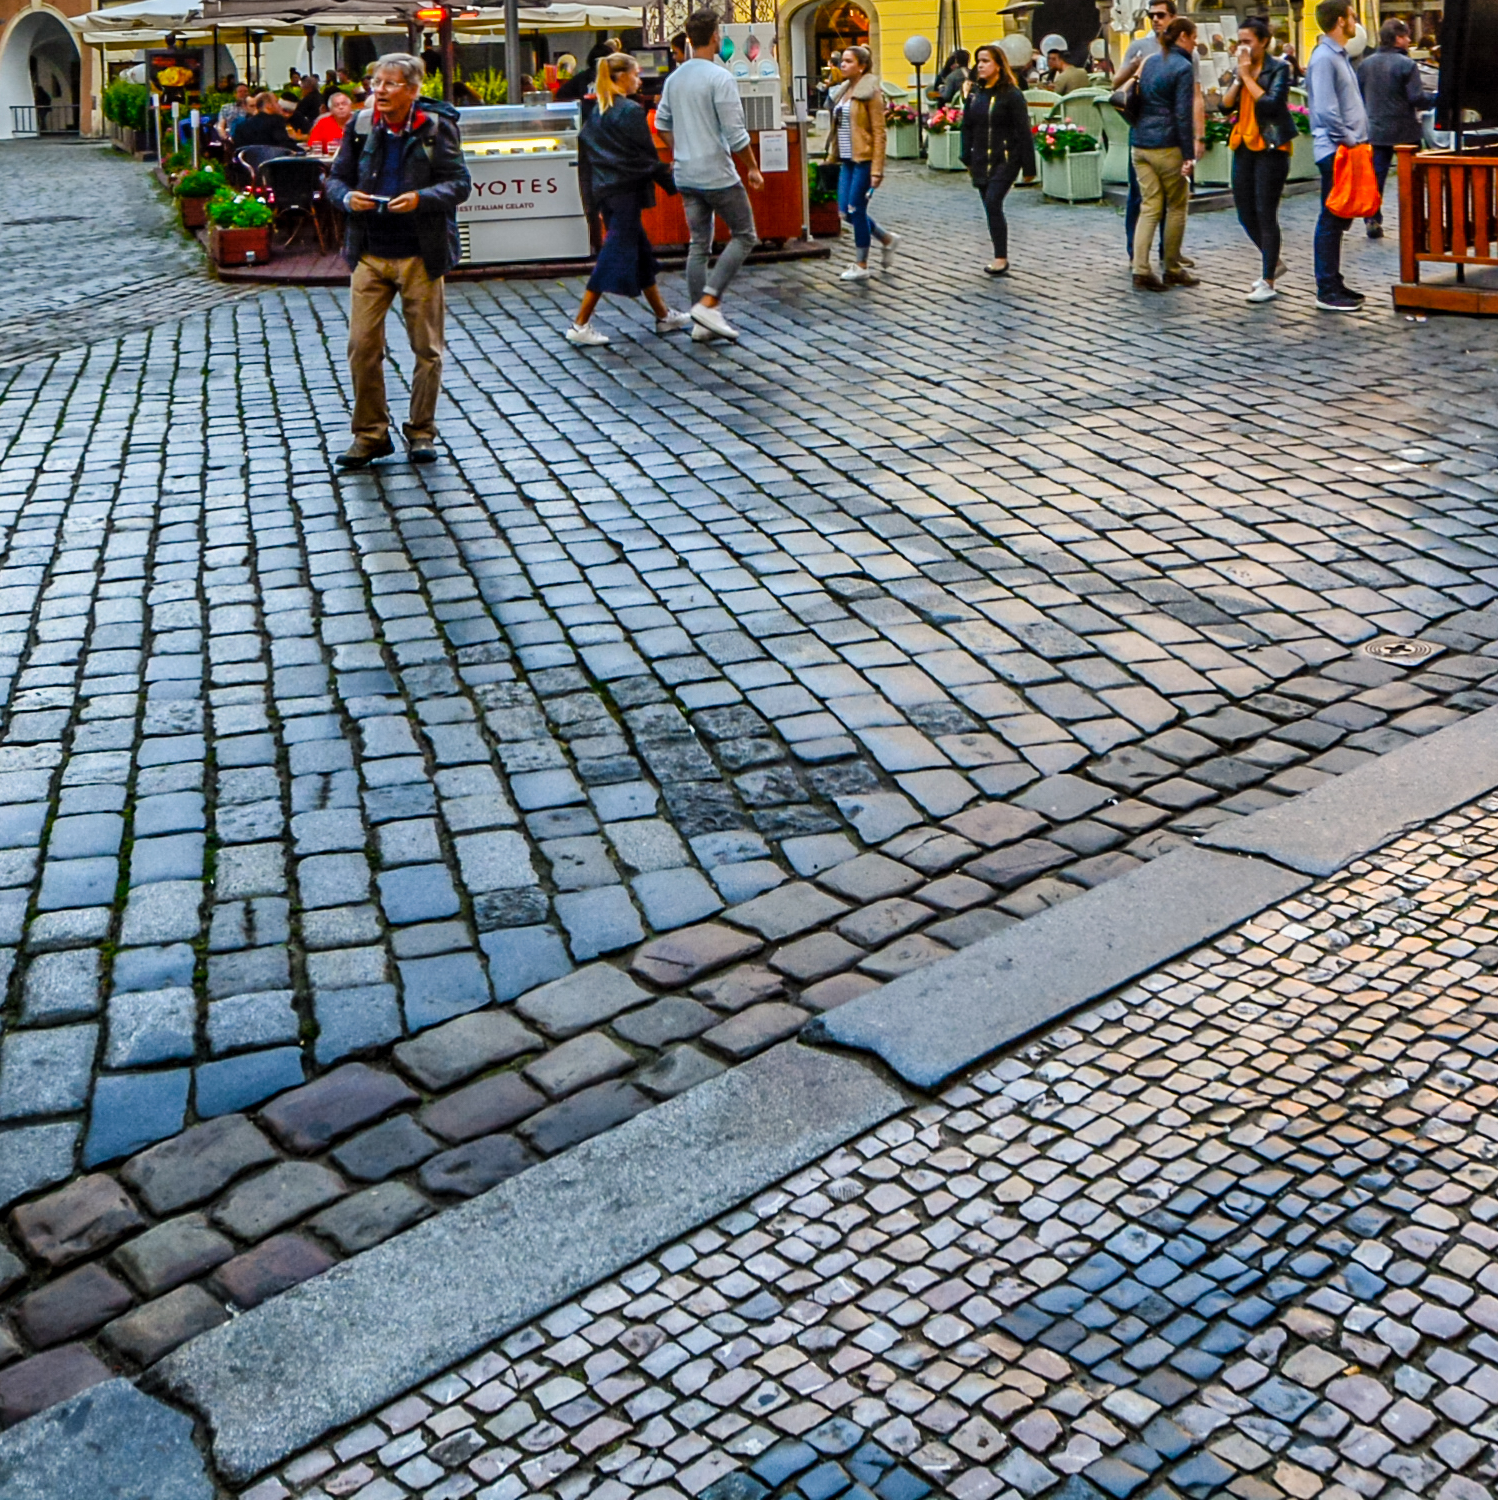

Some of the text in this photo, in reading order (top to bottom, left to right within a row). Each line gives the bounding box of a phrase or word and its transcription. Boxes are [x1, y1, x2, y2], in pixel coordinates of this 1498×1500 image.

[473, 177, 558, 197] YOTES
[474, 203, 503, 212] ITALIAN
[505, 202, 535, 210] GELATO
